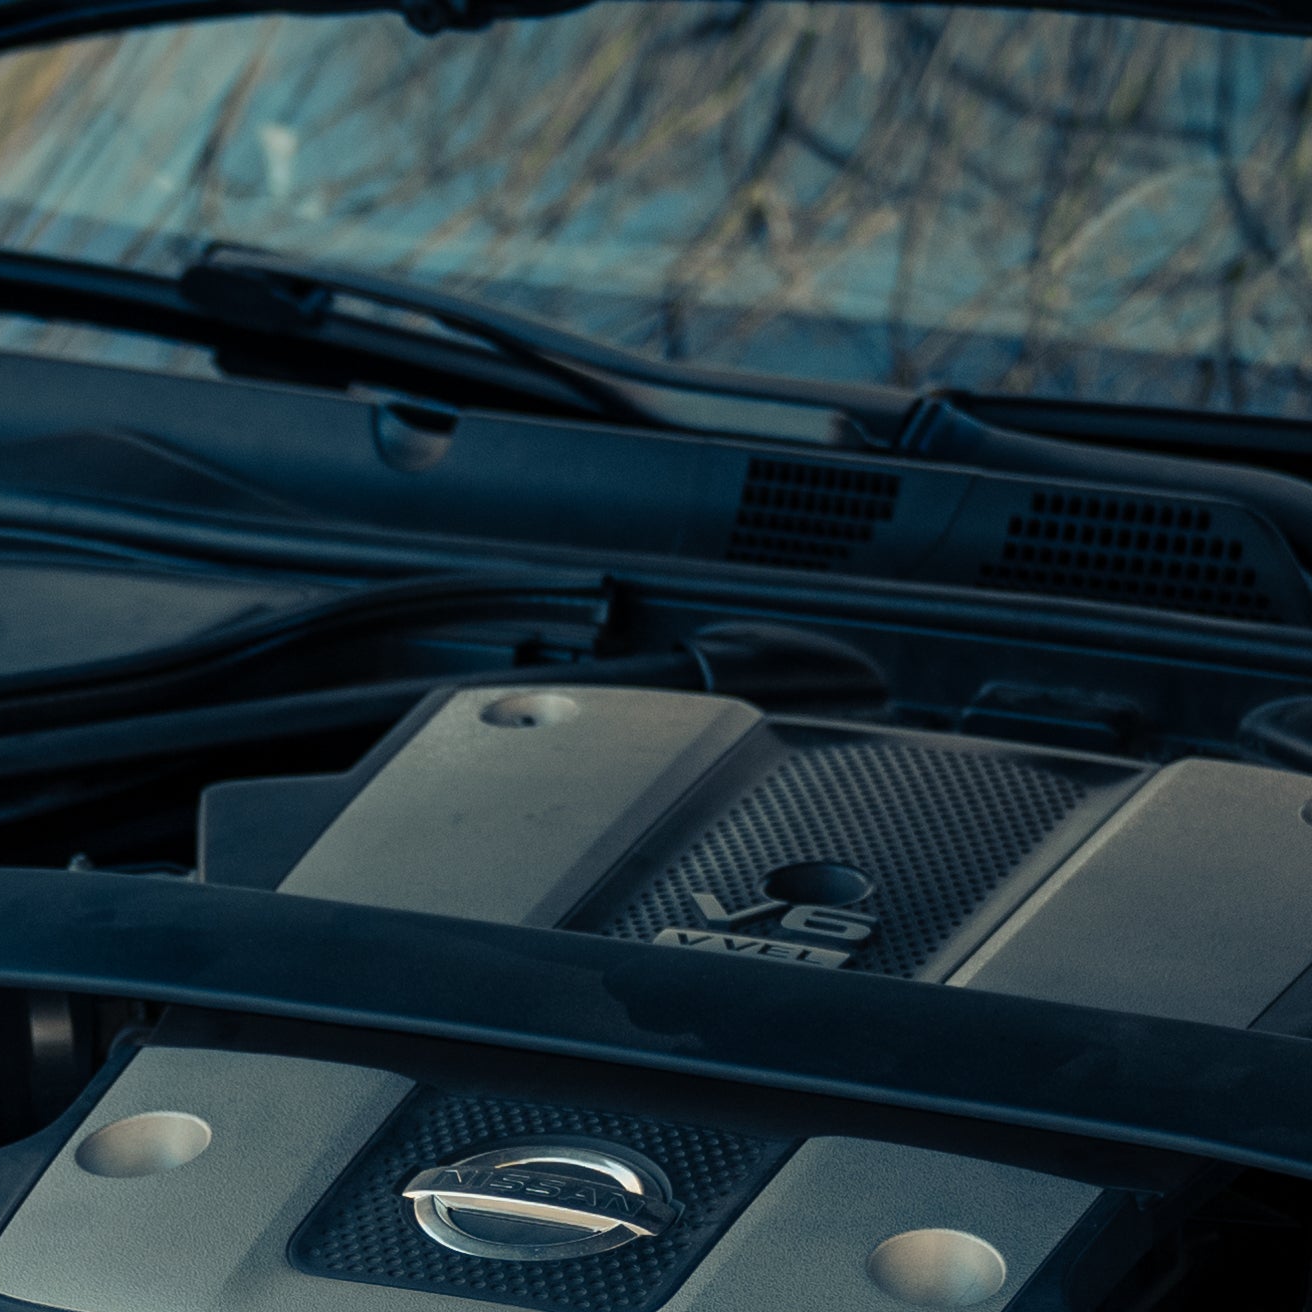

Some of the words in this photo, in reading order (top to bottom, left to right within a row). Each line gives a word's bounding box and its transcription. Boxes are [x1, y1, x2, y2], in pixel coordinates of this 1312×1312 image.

[691, 892, 878, 941] V6
[676, 932, 821, 965] VVEL
[436, 1167, 646, 1217] NISSAN
